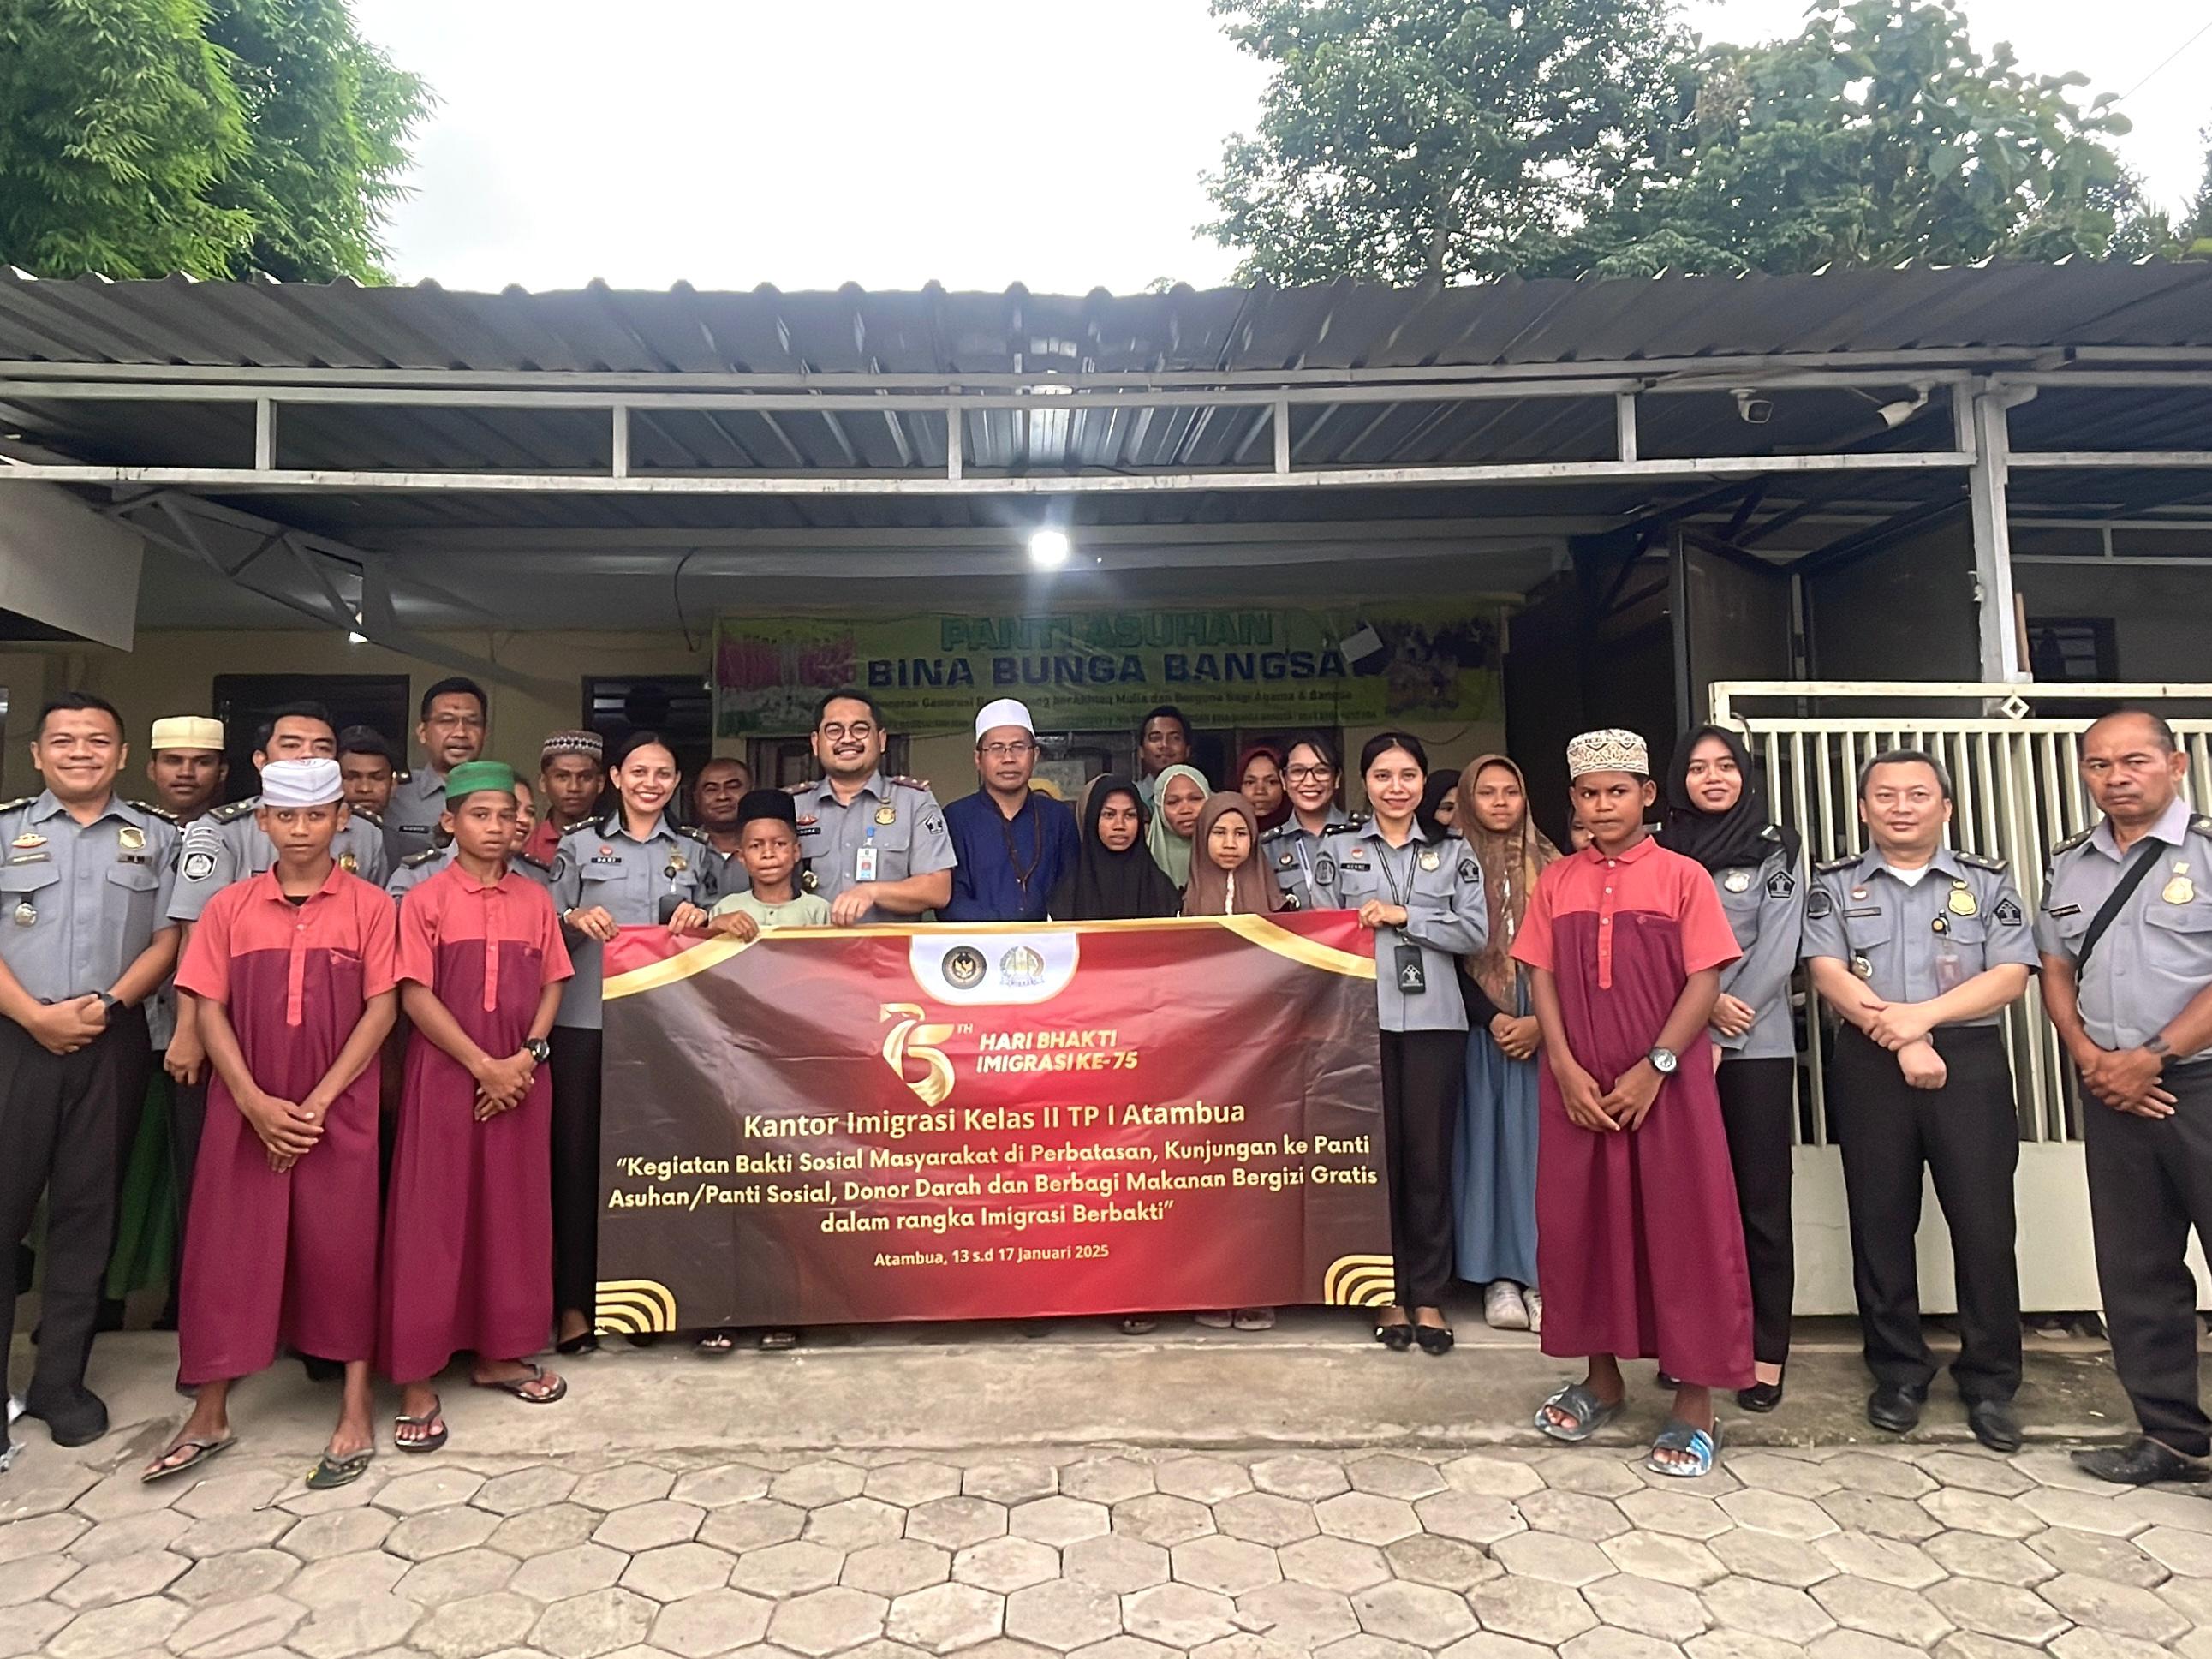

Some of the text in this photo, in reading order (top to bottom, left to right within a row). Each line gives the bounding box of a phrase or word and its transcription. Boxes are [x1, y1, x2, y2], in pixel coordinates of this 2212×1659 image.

[941, 612, 1273, 651] PANTI ASUHAN
[868, 650, 1346, 687] BINA BUNGA BANGSA
[980, 1029, 1118, 1051] HARI BHAKTI
[976, 1051, 1138, 1073] IMIGRASI KE-75
[743, 1101, 1245, 1138] Kantor Imigrasi Kelas II TP I Atambua
[617, 1134, 1370, 1181] “Kegiatan Bakti Sosial Masyarakat di Perbatasan, Kunjungan ke Panti
[608, 1165, 1378, 1211] Asuhan/Panti Sosial, Donor Darah dan Berbagi Makanan Bergizi Gratis
[820, 1200, 1174, 1234] dalam rangka Imigrasi Berbakti”
[874, 1244, 1109, 1266] Atambua, 13 s.d 17 Januari 2025
